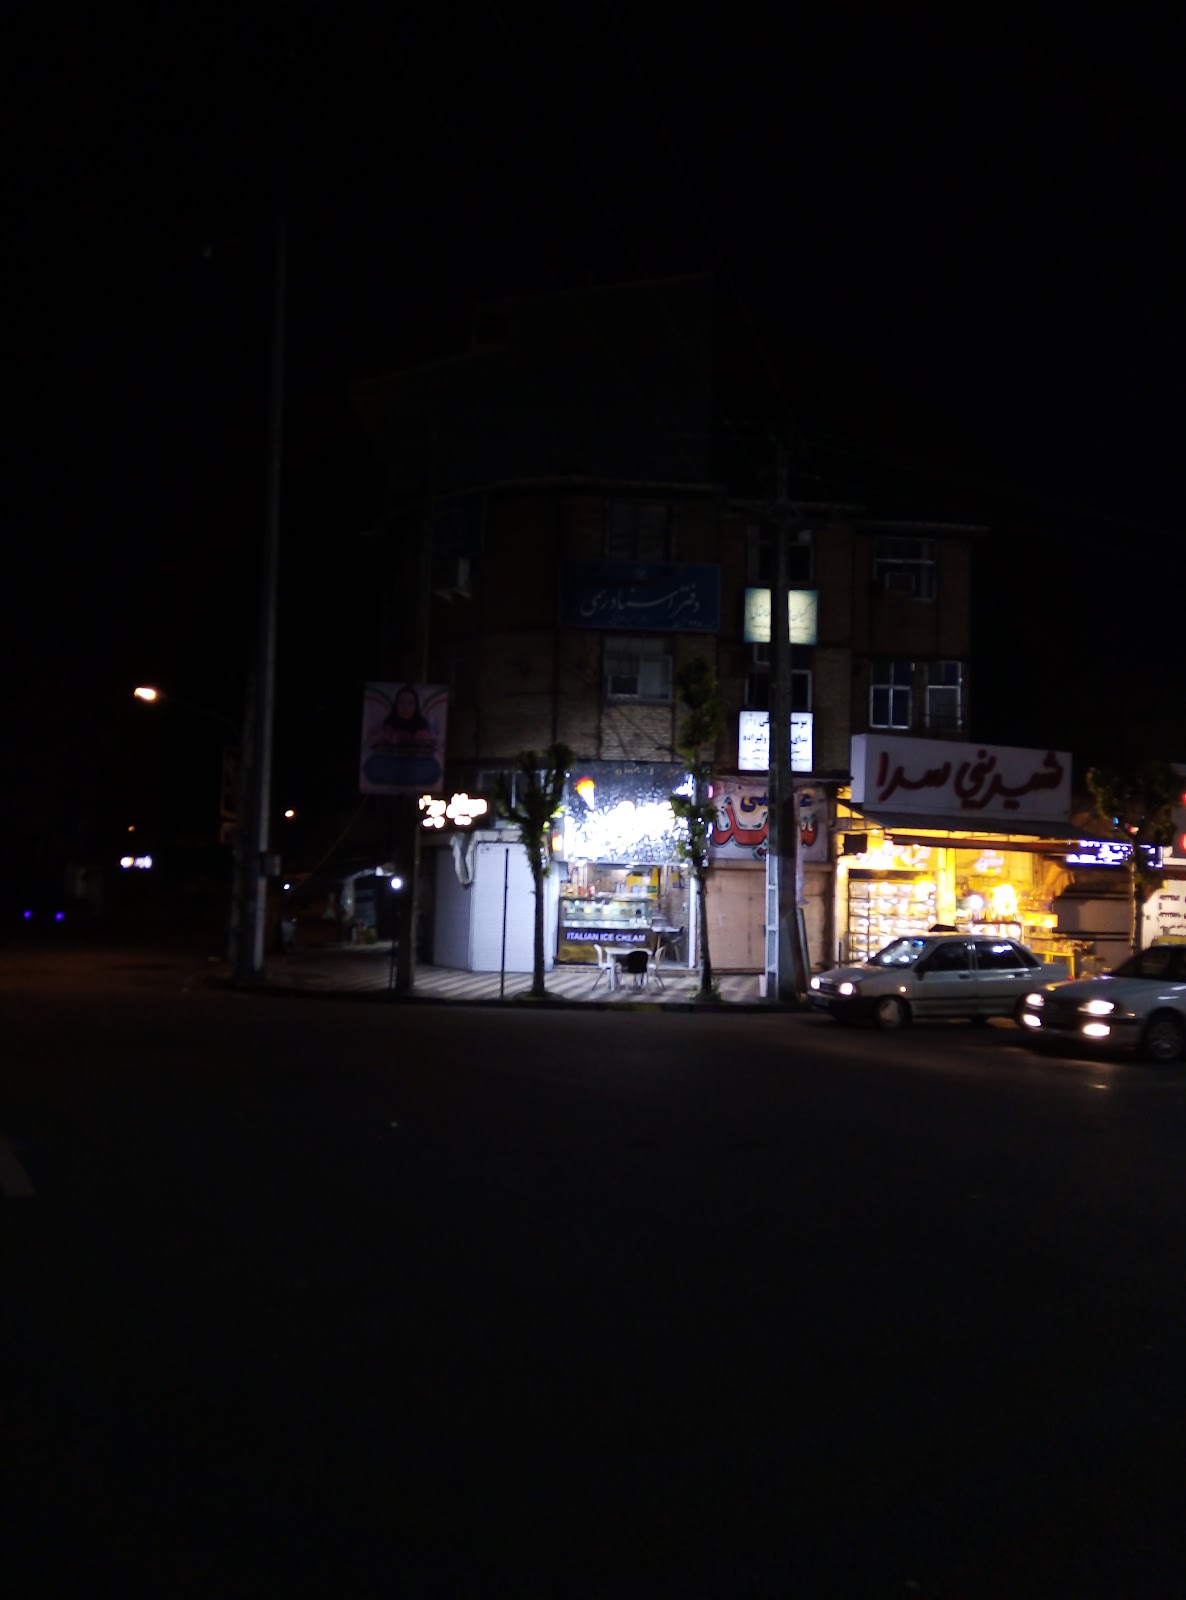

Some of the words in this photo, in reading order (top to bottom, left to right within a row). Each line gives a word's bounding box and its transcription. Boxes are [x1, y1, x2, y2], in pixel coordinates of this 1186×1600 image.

[876, 751, 953, 802] سرا
[955, 749, 1064, 810] شیرینی
[566, 931, 599, 941] ITALIAN
[600, 933, 614, 942] ICE
[615, 934, 645, 943] CREAM
